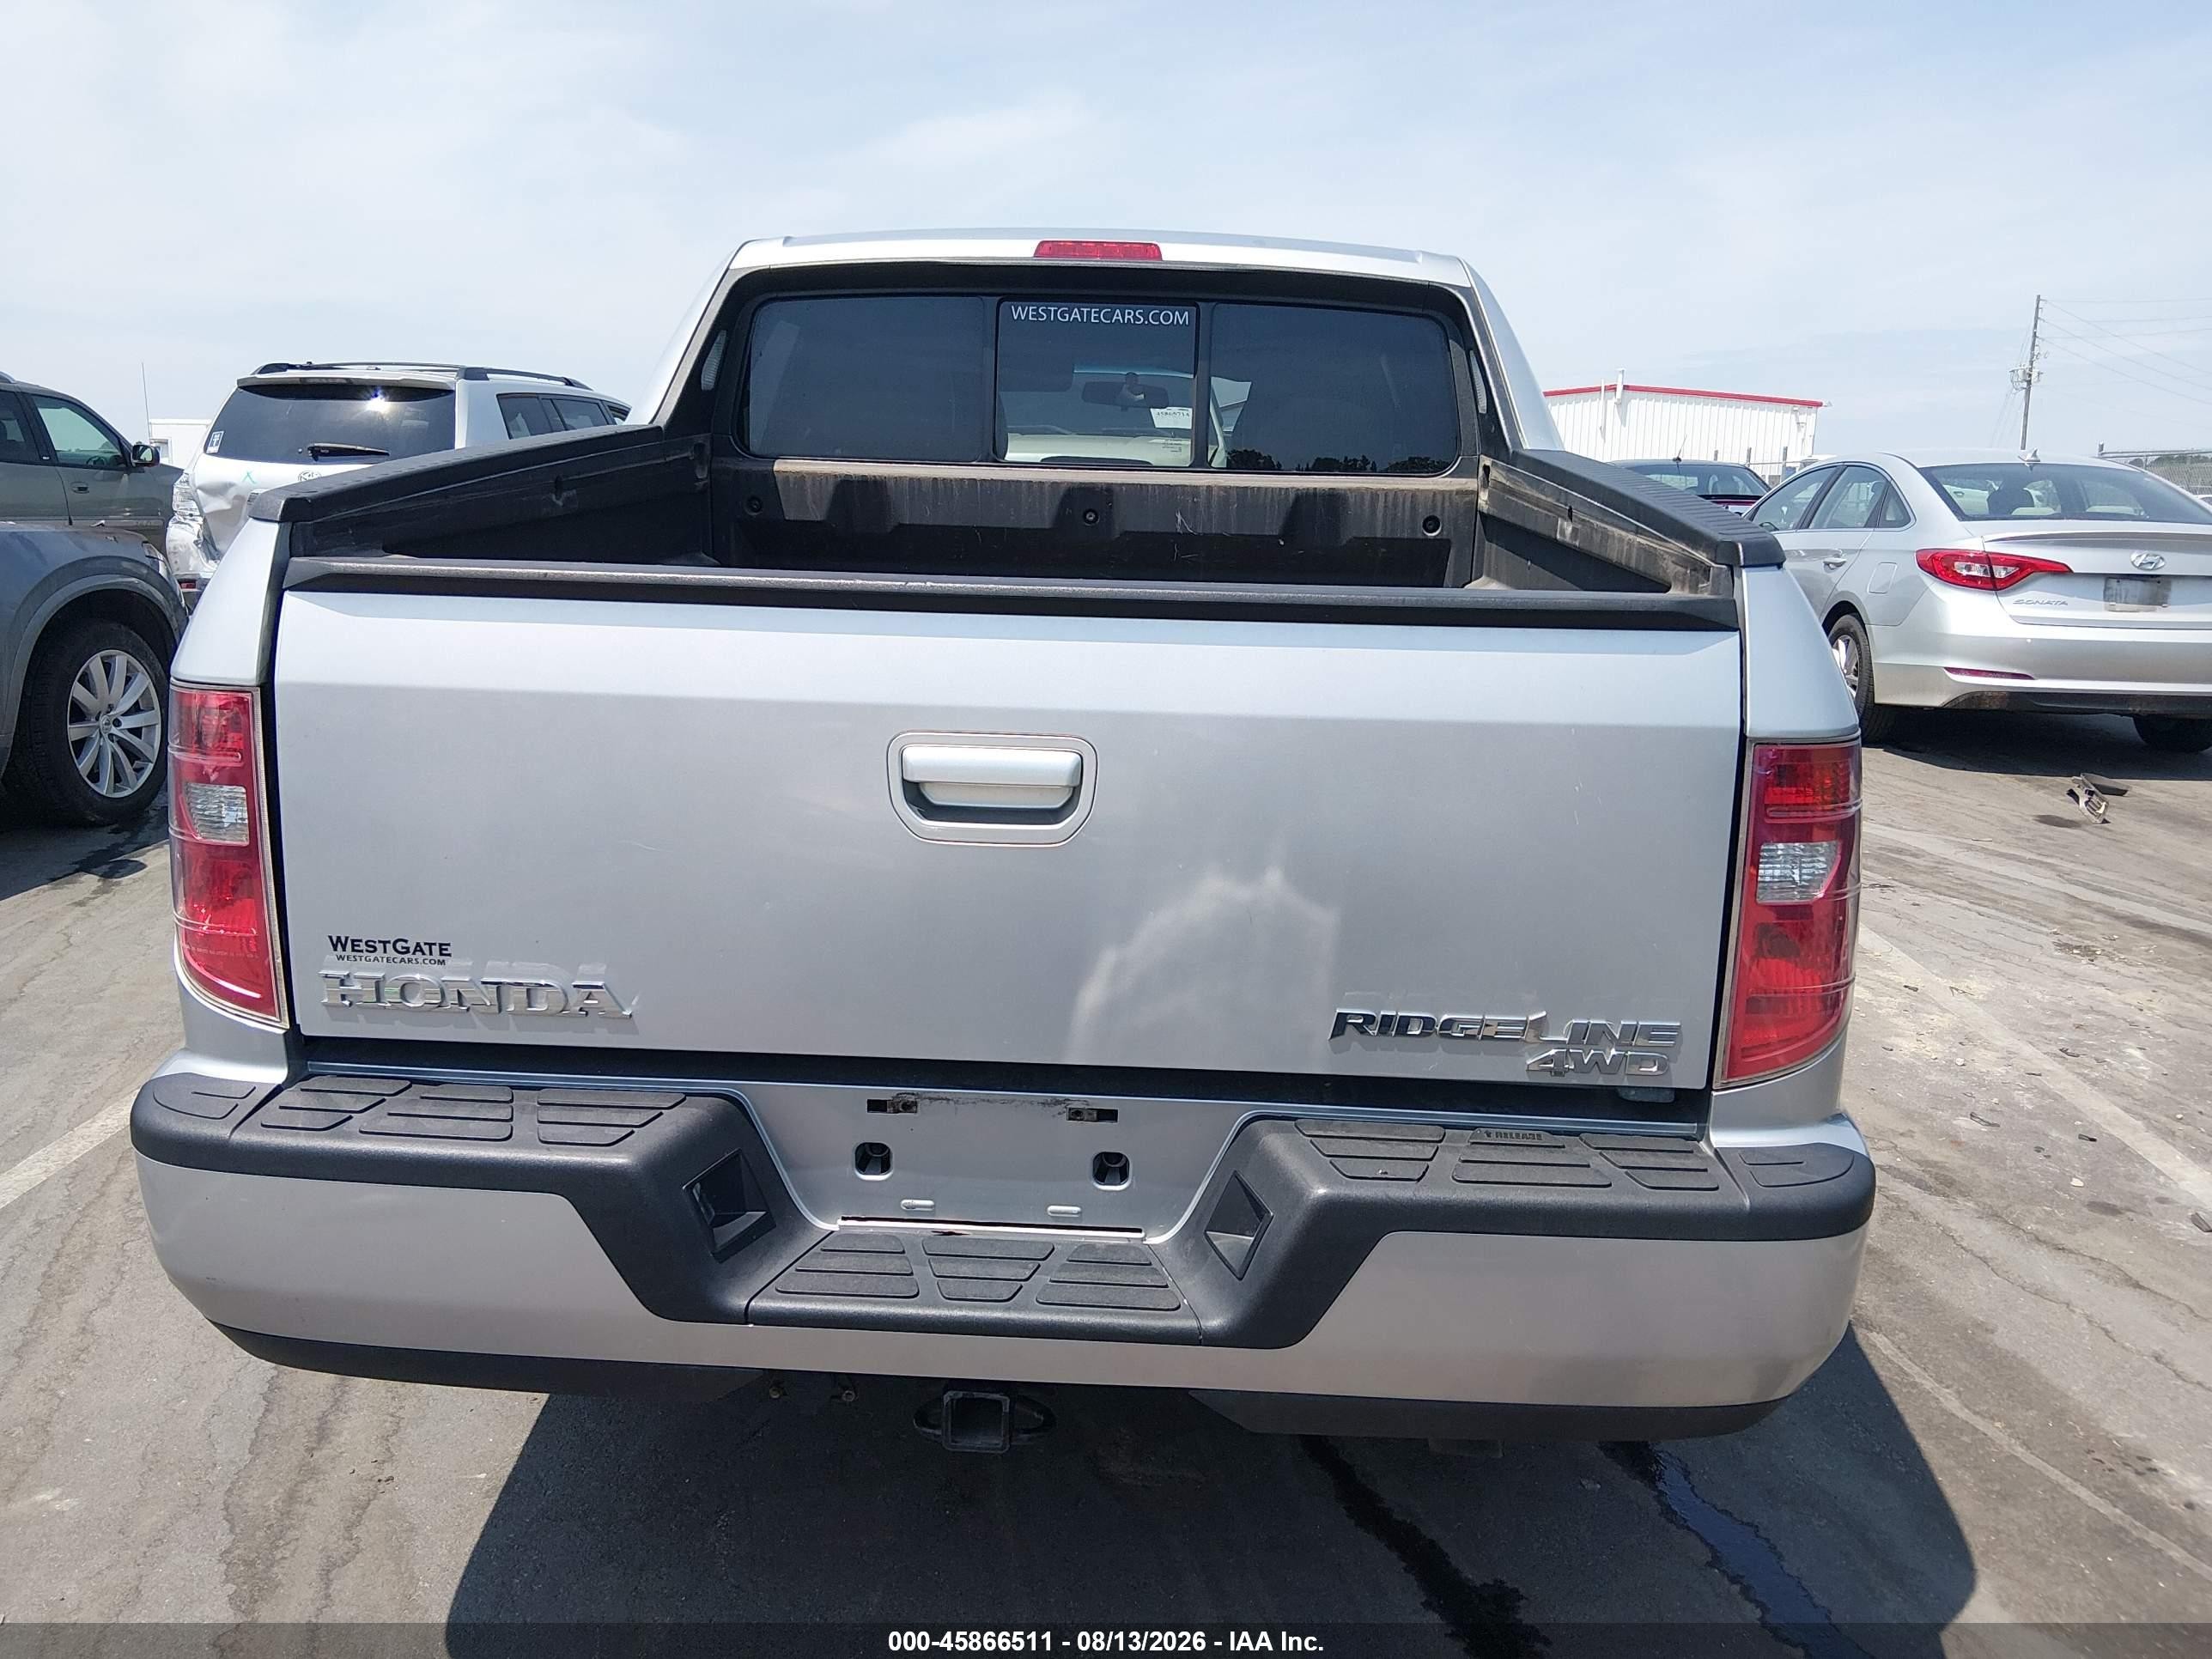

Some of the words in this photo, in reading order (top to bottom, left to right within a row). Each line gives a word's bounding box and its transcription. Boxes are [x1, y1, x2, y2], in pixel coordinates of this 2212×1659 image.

[1011, 305, 1189, 325] WESTGATECARS.COM
[336, 954, 447, 966] WESTGATECARS.COM
[318, 970, 633, 1018] HONDA
[1328, 1007, 1681, 1047] RIDGELINE
[1526, 1047, 1671, 1078] 4WD
